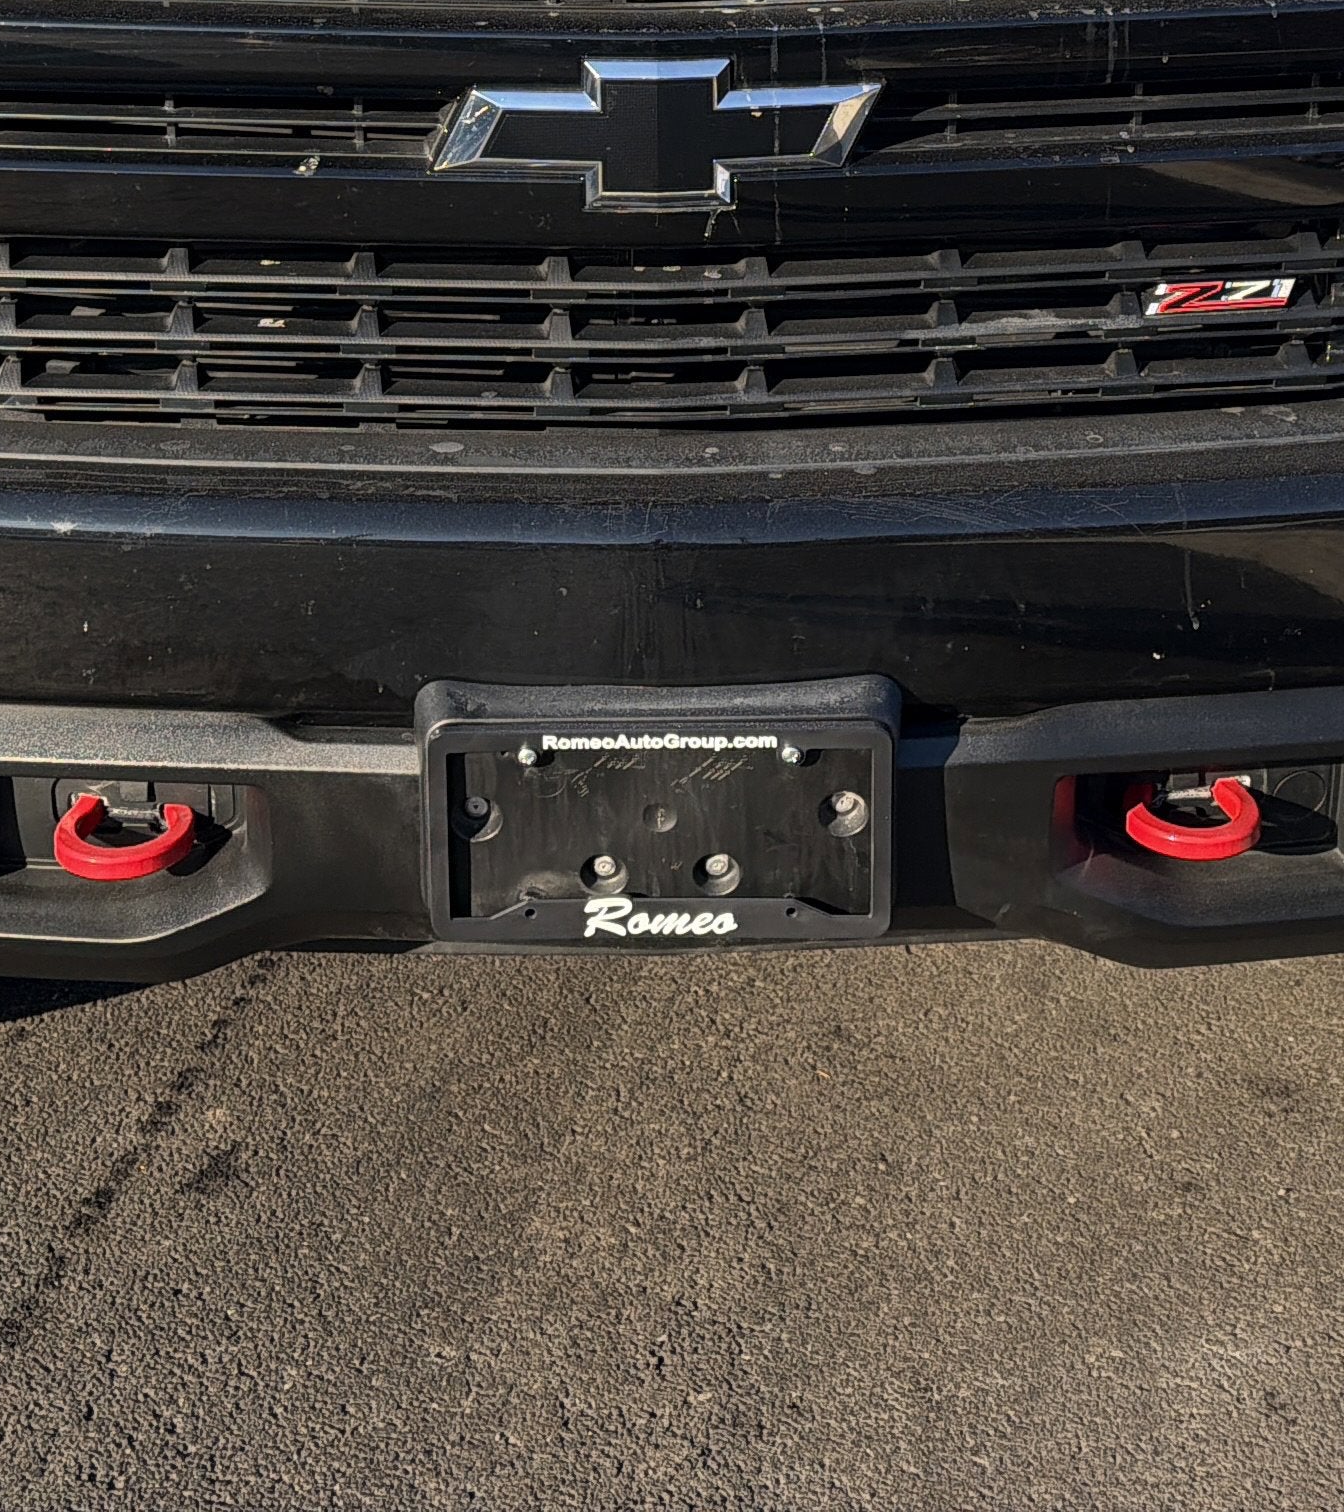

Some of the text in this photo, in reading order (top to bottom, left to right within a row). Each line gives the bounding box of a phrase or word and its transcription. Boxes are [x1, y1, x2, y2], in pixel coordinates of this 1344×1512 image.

[1145, 278, 1297, 316] Z71
[542, 733, 778, 752] RomeoAutoGroup.com
[583, 897, 739, 938] Romeo
